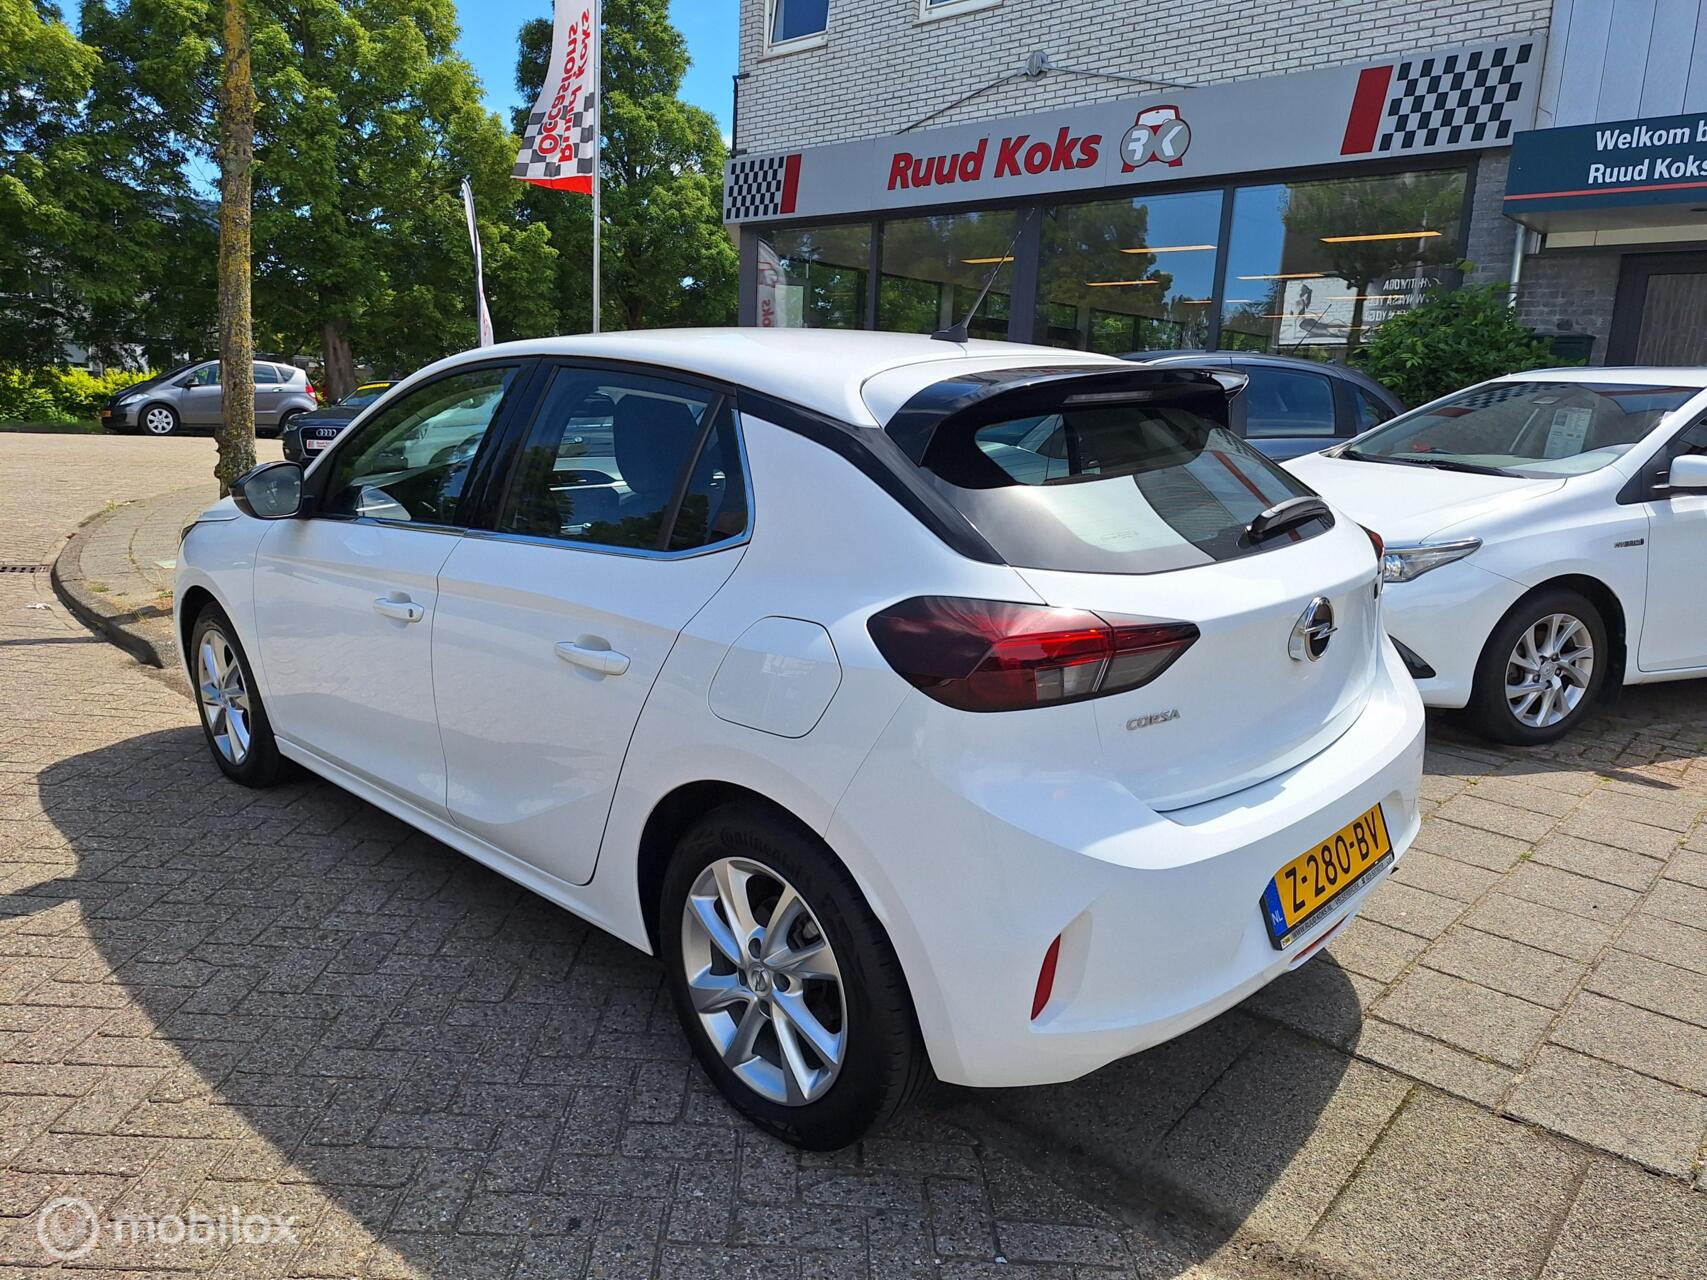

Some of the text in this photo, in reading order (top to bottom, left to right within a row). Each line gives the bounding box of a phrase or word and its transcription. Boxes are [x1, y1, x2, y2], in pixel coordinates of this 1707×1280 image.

[1595, 125, 1690, 151] Welkom
[887, 126, 1102, 190] Ruud Koks
[1588, 155, 1707, 184] Ruud Koks
[1126, 709, 1181, 731] CORSA
[1285, 811, 1379, 913] Z-280-BV
[1271, 909, 1284, 926] NL
